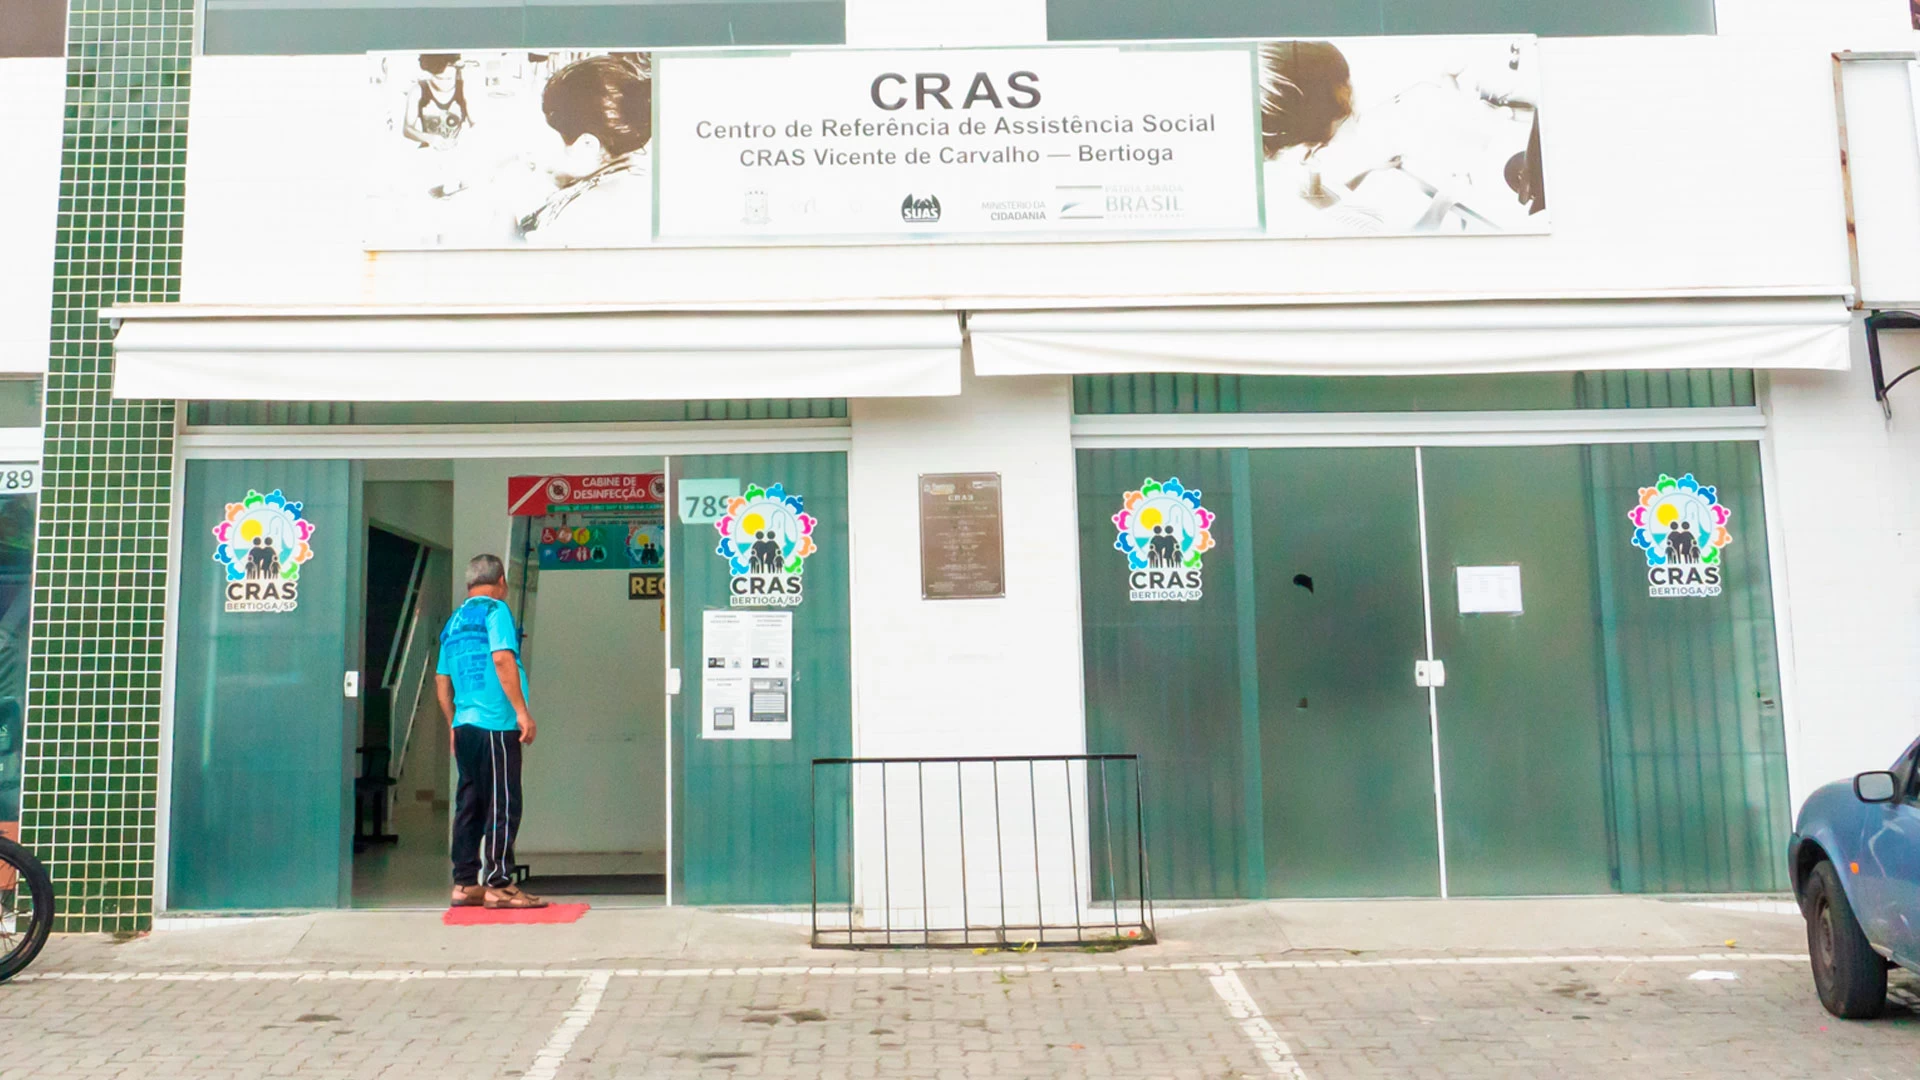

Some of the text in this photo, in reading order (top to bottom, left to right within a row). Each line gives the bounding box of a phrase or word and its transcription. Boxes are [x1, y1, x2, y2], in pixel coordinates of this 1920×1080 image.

[870, 71, 1041, 110] CRAS
[695, 114, 1215, 138] Centro de Referência de Assistência Social
[739, 148, 806, 167] CRAS
[813, 148, 897, 165] Vicente
[904, 147, 931, 165] de
[939, 145, 1040, 164] Carvalho
[1078, 144, 1173, 166] Bertioga
[1105, 194, 1184, 212] BRASIL
[990, 211, 1046, 220] CIDADANIA
[582, 476, 637, 487] CABINE DE
[1131, 571, 1200, 589] CRAS
[1650, 567, 1719, 585] CRAS
[227, 582, 296, 601] CRAS
[732, 577, 801, 595] CRAS
[1651, 586, 1720, 595] BERTIOGA/SP
[732, 596, 801, 605] BERTIOGA/SP
[1131, 591, 1201, 600] BERTIOGA/SP
[226, 602, 296, 611] BERTIOGA/SP
